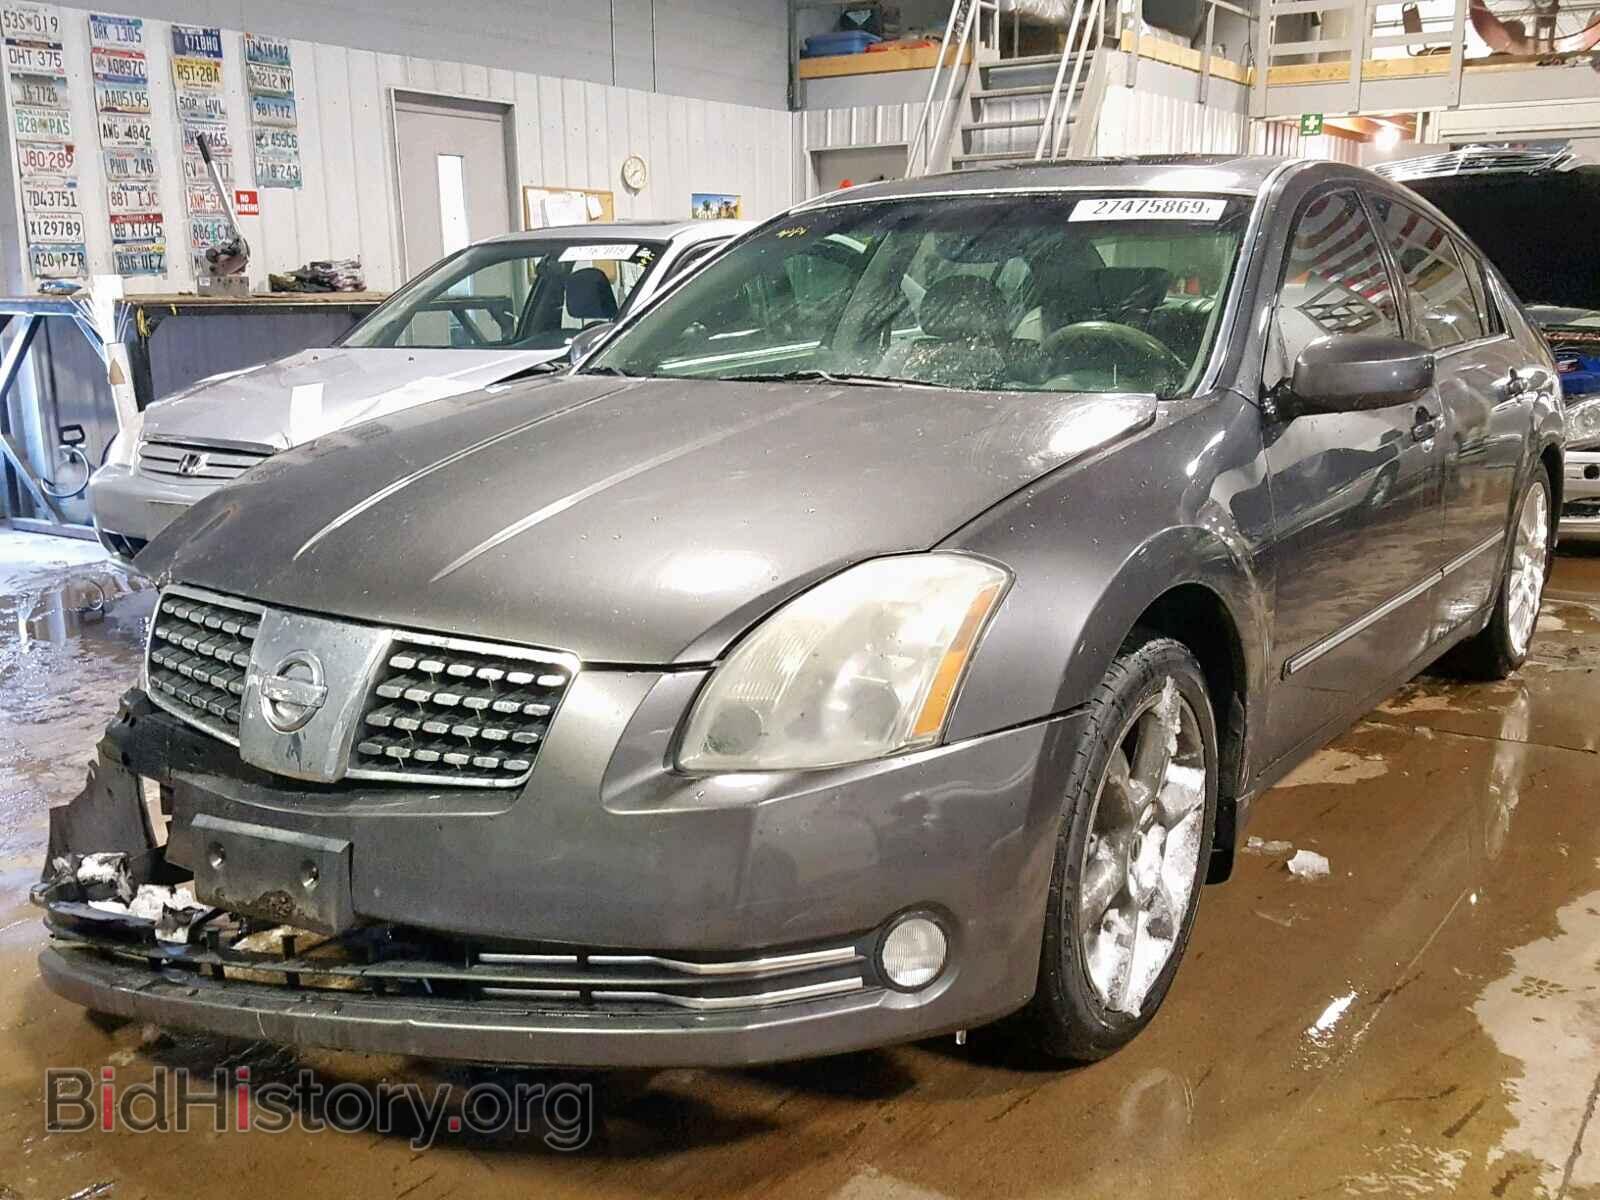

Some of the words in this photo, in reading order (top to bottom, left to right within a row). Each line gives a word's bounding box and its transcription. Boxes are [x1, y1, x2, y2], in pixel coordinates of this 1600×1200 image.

[3, 10, 25, 29] 53S
[34, 15, 58, 33] 019
[115, 26, 142, 43] 1305
[38, 51, 62, 67] 375
[205, 98, 226, 115] HVL
[50, 118, 70, 135] PAS
[117, 182, 148, 193] Arkansas
[27, 190, 77, 208] 7D43751
[240, 194, 249, 203] NO
[1093, 199, 1206, 215] 27475869
[30, 220, 81, 236] X129789
[35, 251, 54, 267] 420
[62, 252, 85, 268] PZR
